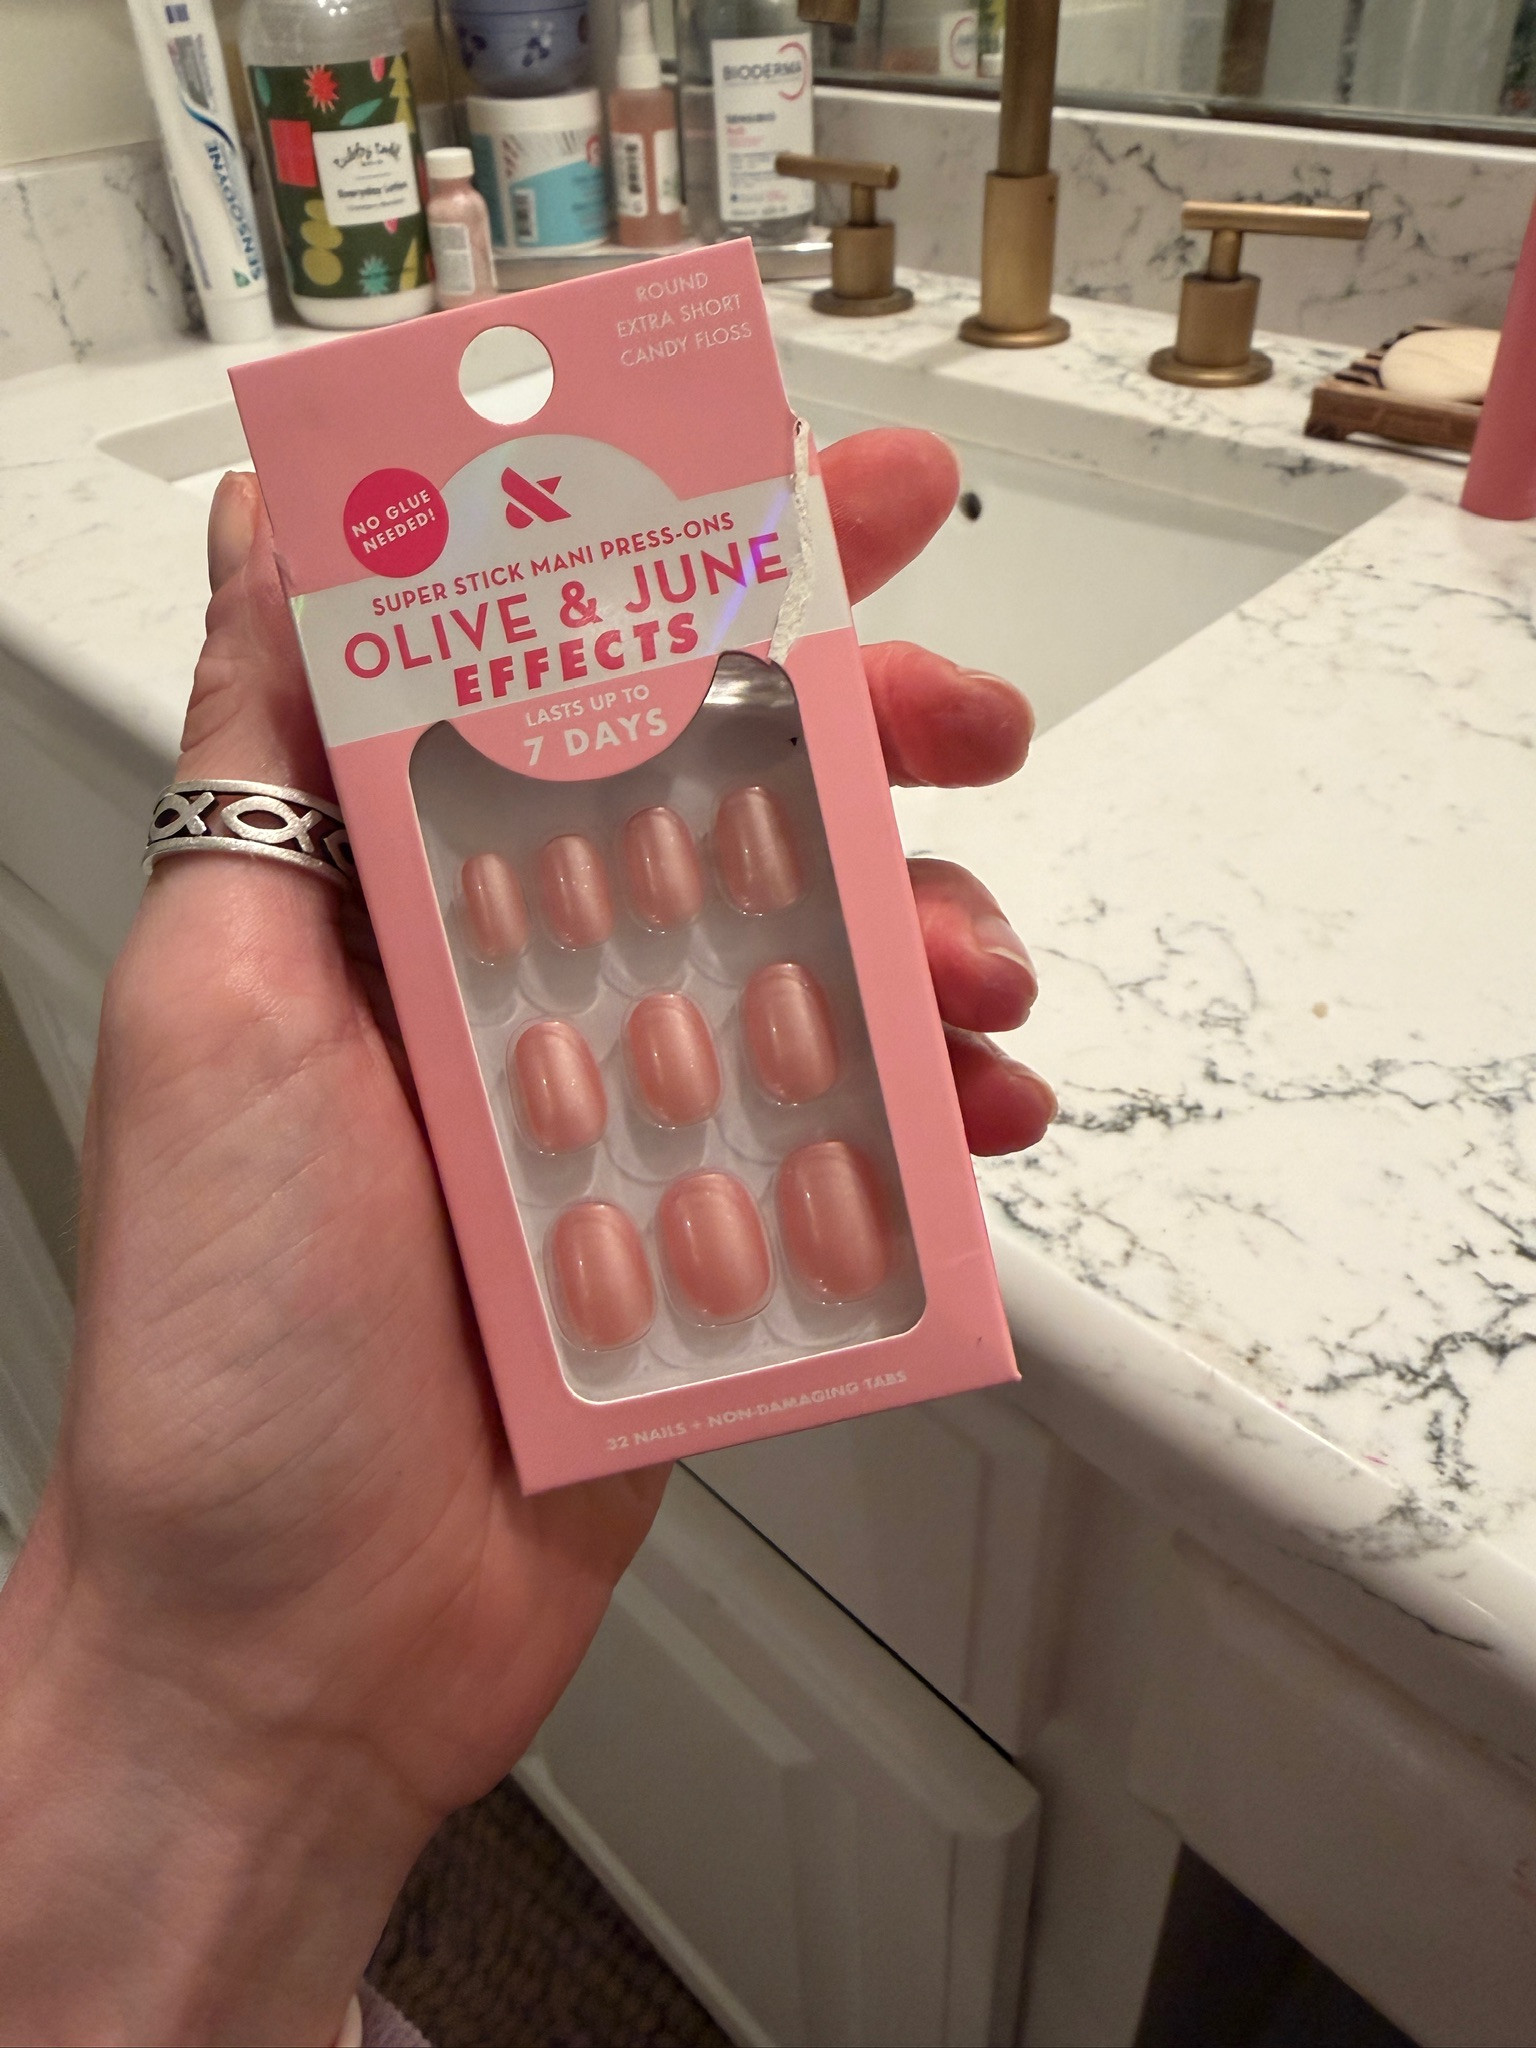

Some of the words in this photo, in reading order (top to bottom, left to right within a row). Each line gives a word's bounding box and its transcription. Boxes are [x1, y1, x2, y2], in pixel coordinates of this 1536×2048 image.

[723, 60, 802, 82] BIODERMA
[636, 271, 709, 302] ROUND
[616, 310, 675, 338] EXTRA
[679, 293, 741, 323] SHORT
[619, 336, 688, 367] CANDY
[694, 321, 752, 350] FLOSS
[351, 515, 380, 538] NO
[385, 489, 431, 520] GLUE
[362, 507, 436, 554] NEEDED!
[372, 582, 448, 616] SUPER
[453, 562, 525, 595] STICK
[530, 545, 594, 577] MANI
[600, 511, 734, 560] PRESS-ONS
[344, 592, 538, 679] OLIVE
[559, 580, 604, 629] &
[624, 532, 788, 614] JUNE
[454, 612, 699, 708] EFFECTS
[525, 699, 584, 728] LASTS
[589, 692, 617, 712] UP
[621, 684, 650, 704] TO
[523, 735, 544, 767] 7
[564, 707, 668, 757] DAYS
[606, 1435, 630, 1452] 32
[634, 1421, 687, 1445] NAILS
[708, 1381, 860, 1429] NON-DAMAGING
[864, 1369, 908, 1391] TABS
